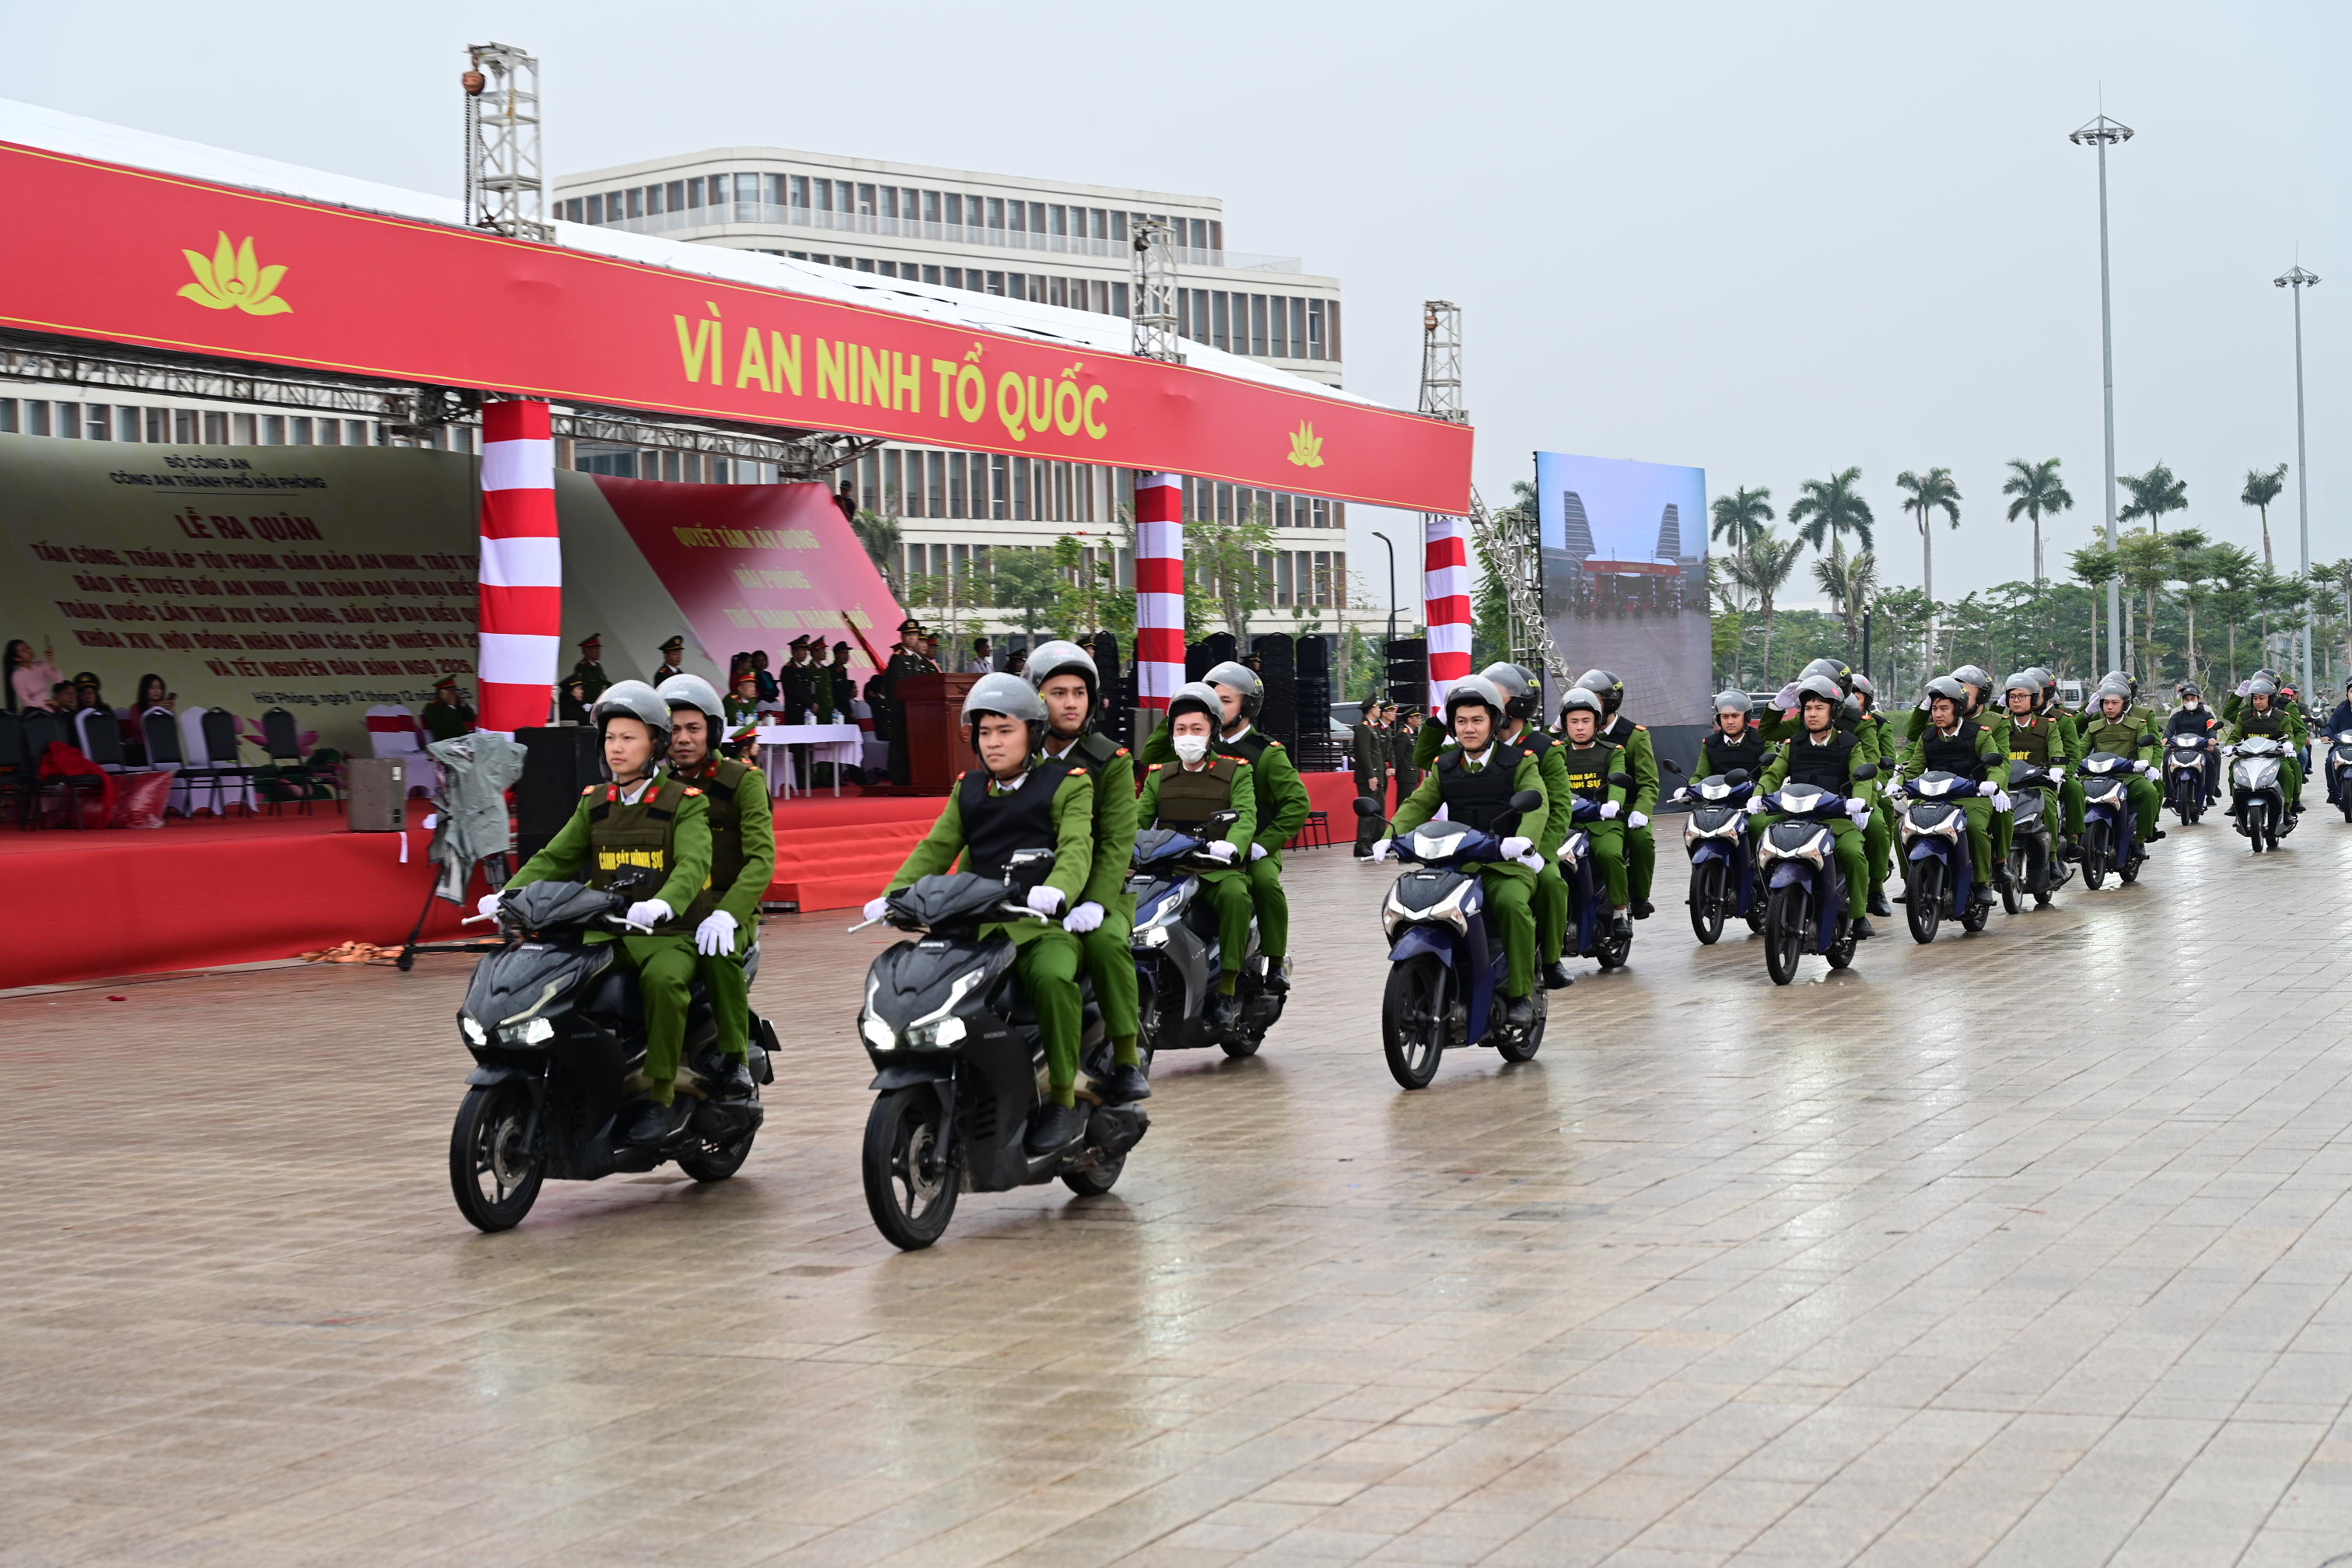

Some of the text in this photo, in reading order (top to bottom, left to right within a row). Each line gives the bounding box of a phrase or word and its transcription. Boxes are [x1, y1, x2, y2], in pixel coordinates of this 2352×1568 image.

[674, 301, 1108, 441] VÌ AN NINH TỔ QUỐC
[163, 454, 253, 471] BỘ CÔNG AN
[110, 470, 154, 485] CÔNG
[153, 474, 177, 487] AN
[173, 473, 222, 488] THÀNH
[278, 473, 327, 489] PHÒNG
[173, 506, 324, 542] LỄ RA QUÂN
[672, 522, 721, 548] QUYẾT
[715, 525, 753, 548] TÂM
[747, 526, 781, 548] XÂY
[355, 554, 383, 569] AN
[110, 573, 141, 597] VỆ
[136, 575, 191, 597] TUYỆT
[222, 580, 250, 596] AN
[296, 581, 324, 597] AN
[325, 631, 361, 649] CÁC
[391, 630, 446, 651] NHIỆM
[205, 656, 236, 676] VÀ
[230, 656, 264, 677] TẾT
[261, 657, 331, 677] NGUYÊN
[599, 846, 663, 871] CẢNH SÁT HÌNH SỰ
